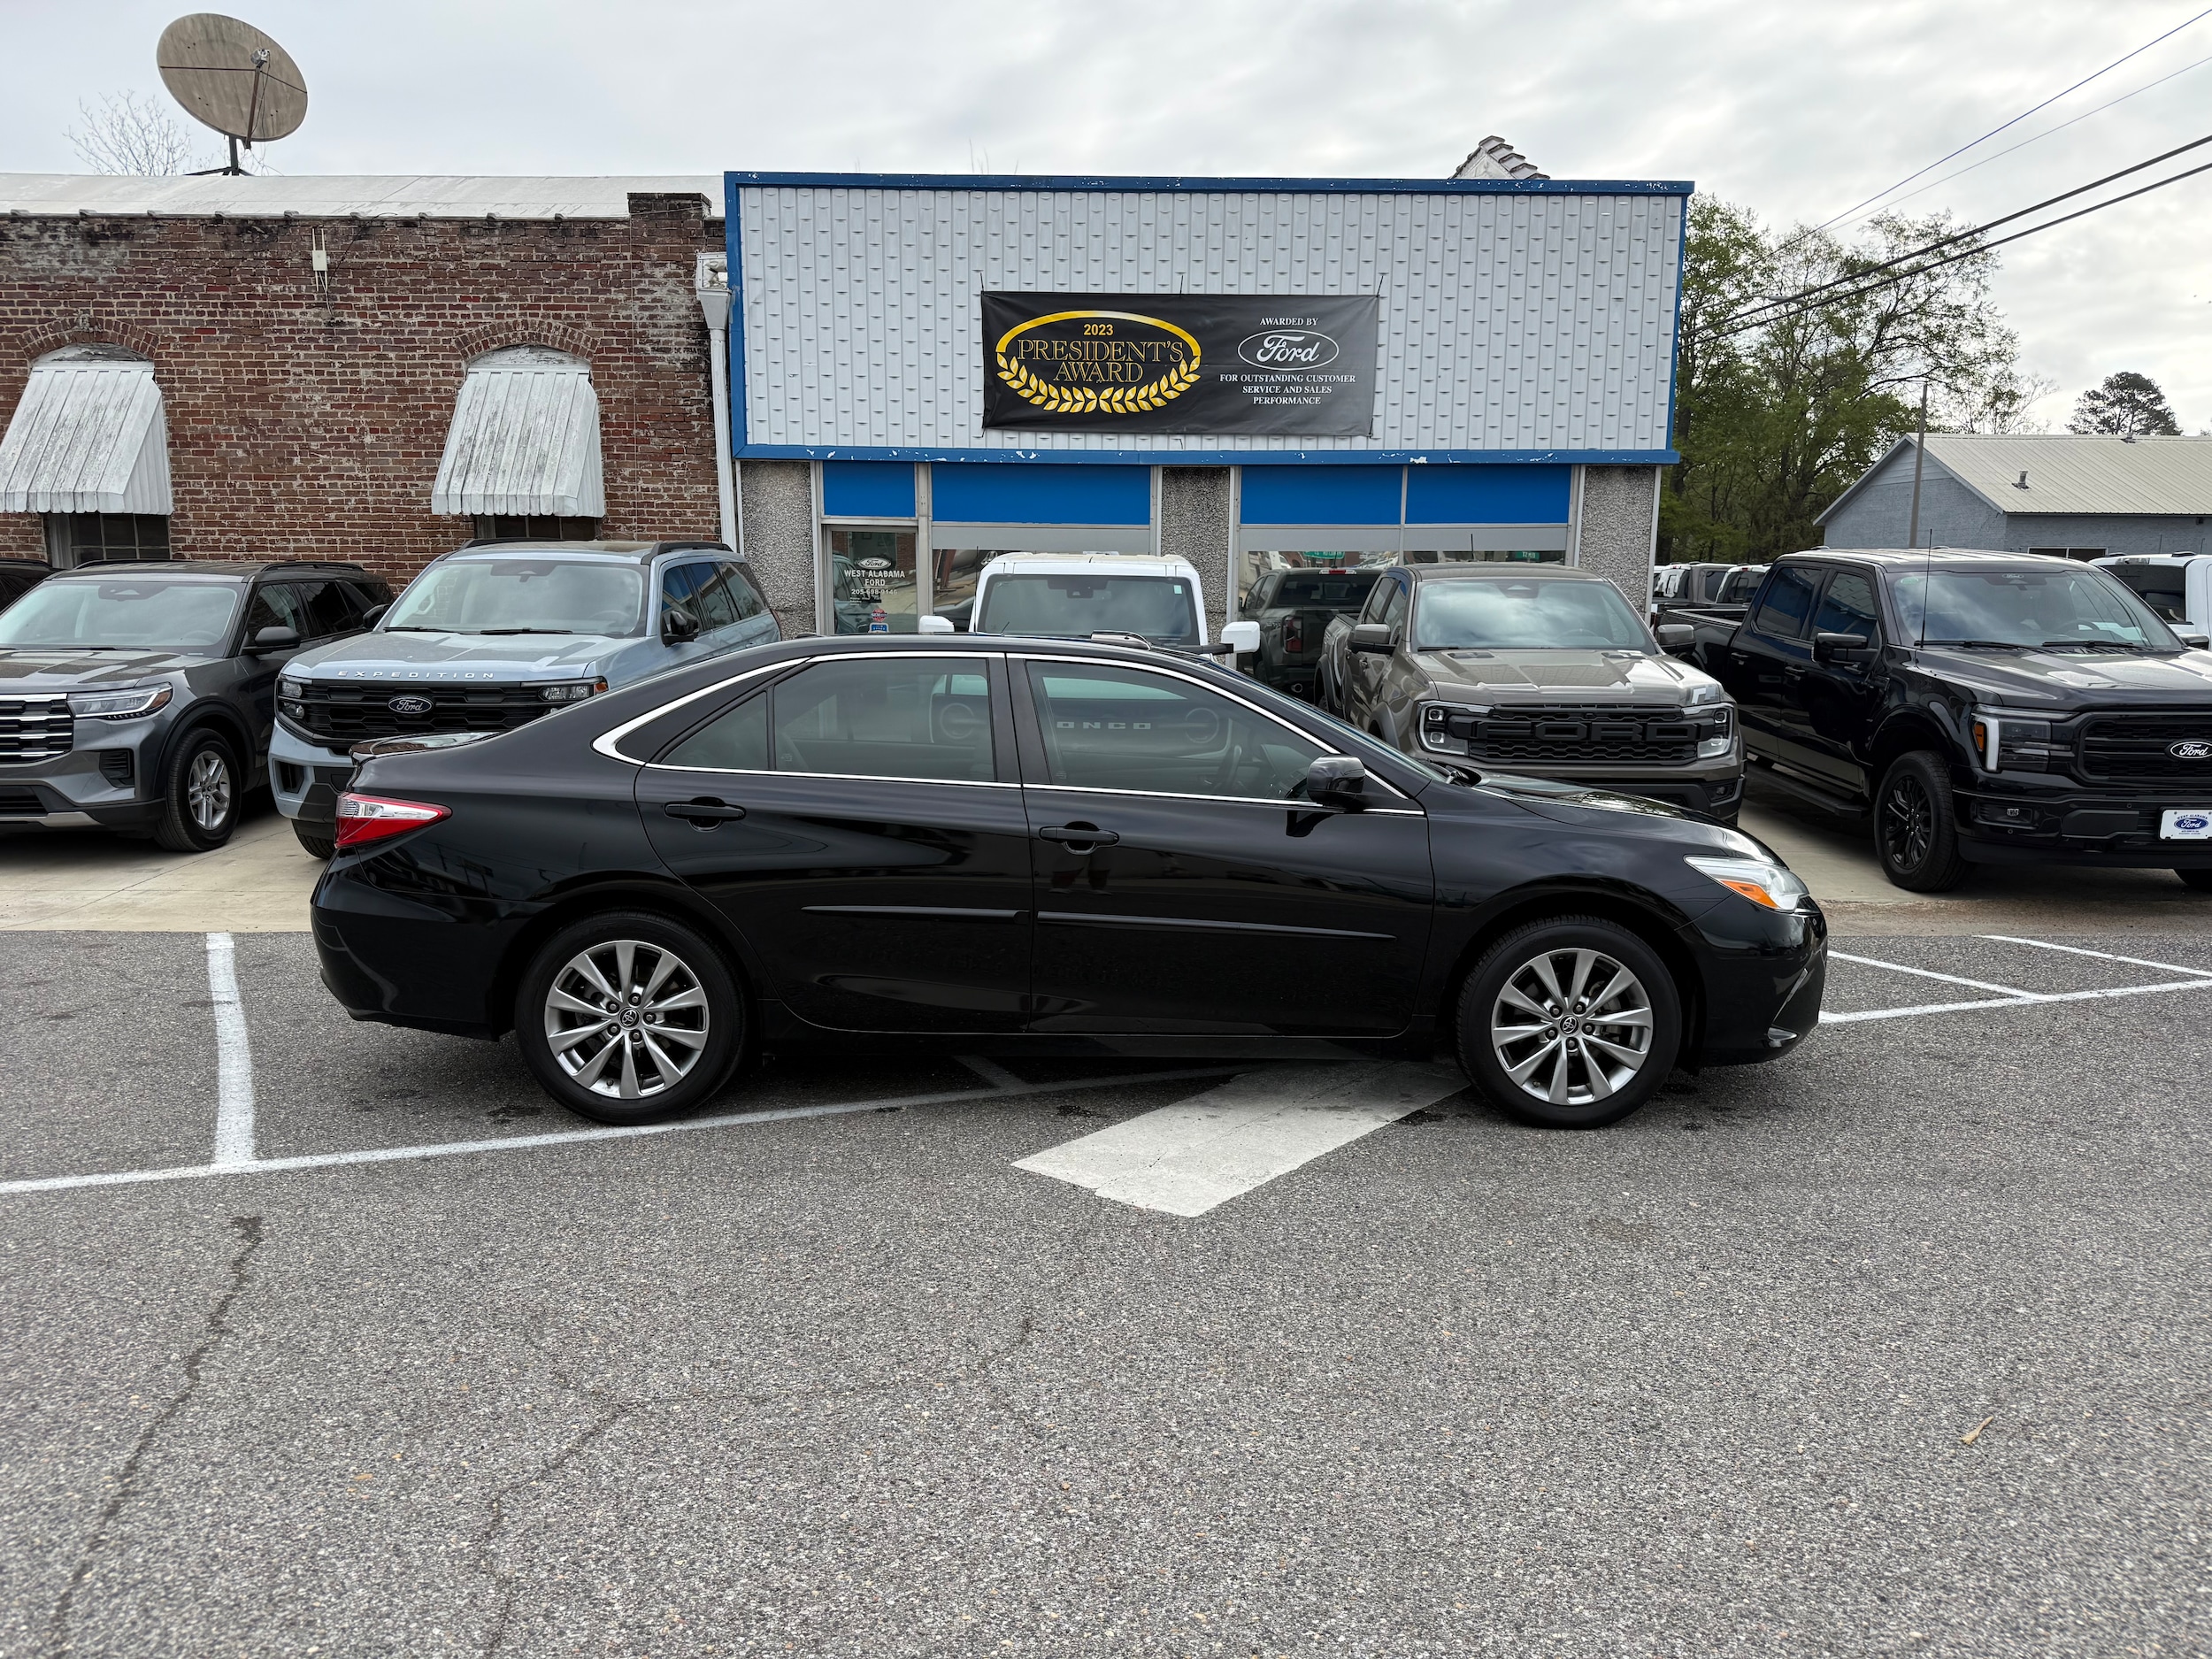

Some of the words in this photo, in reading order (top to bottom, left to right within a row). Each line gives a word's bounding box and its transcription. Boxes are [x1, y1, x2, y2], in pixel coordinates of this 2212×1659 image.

[1083, 324, 1114, 336] 2023
[1018, 339, 1184, 363] PRESIDENT'S
[1256, 335, 1320, 362] Ford
[1053, 361, 1143, 383] AWARD
[1306, 374, 1356, 383] CUSTOMER
[396, 700, 423, 711] Ford
[1056, 721, 1151, 730] ONCO
[1476, 721, 1699, 741] FORD
[2178, 743, 2208, 756] Ford
[2180, 818, 2202, 828] Ford
